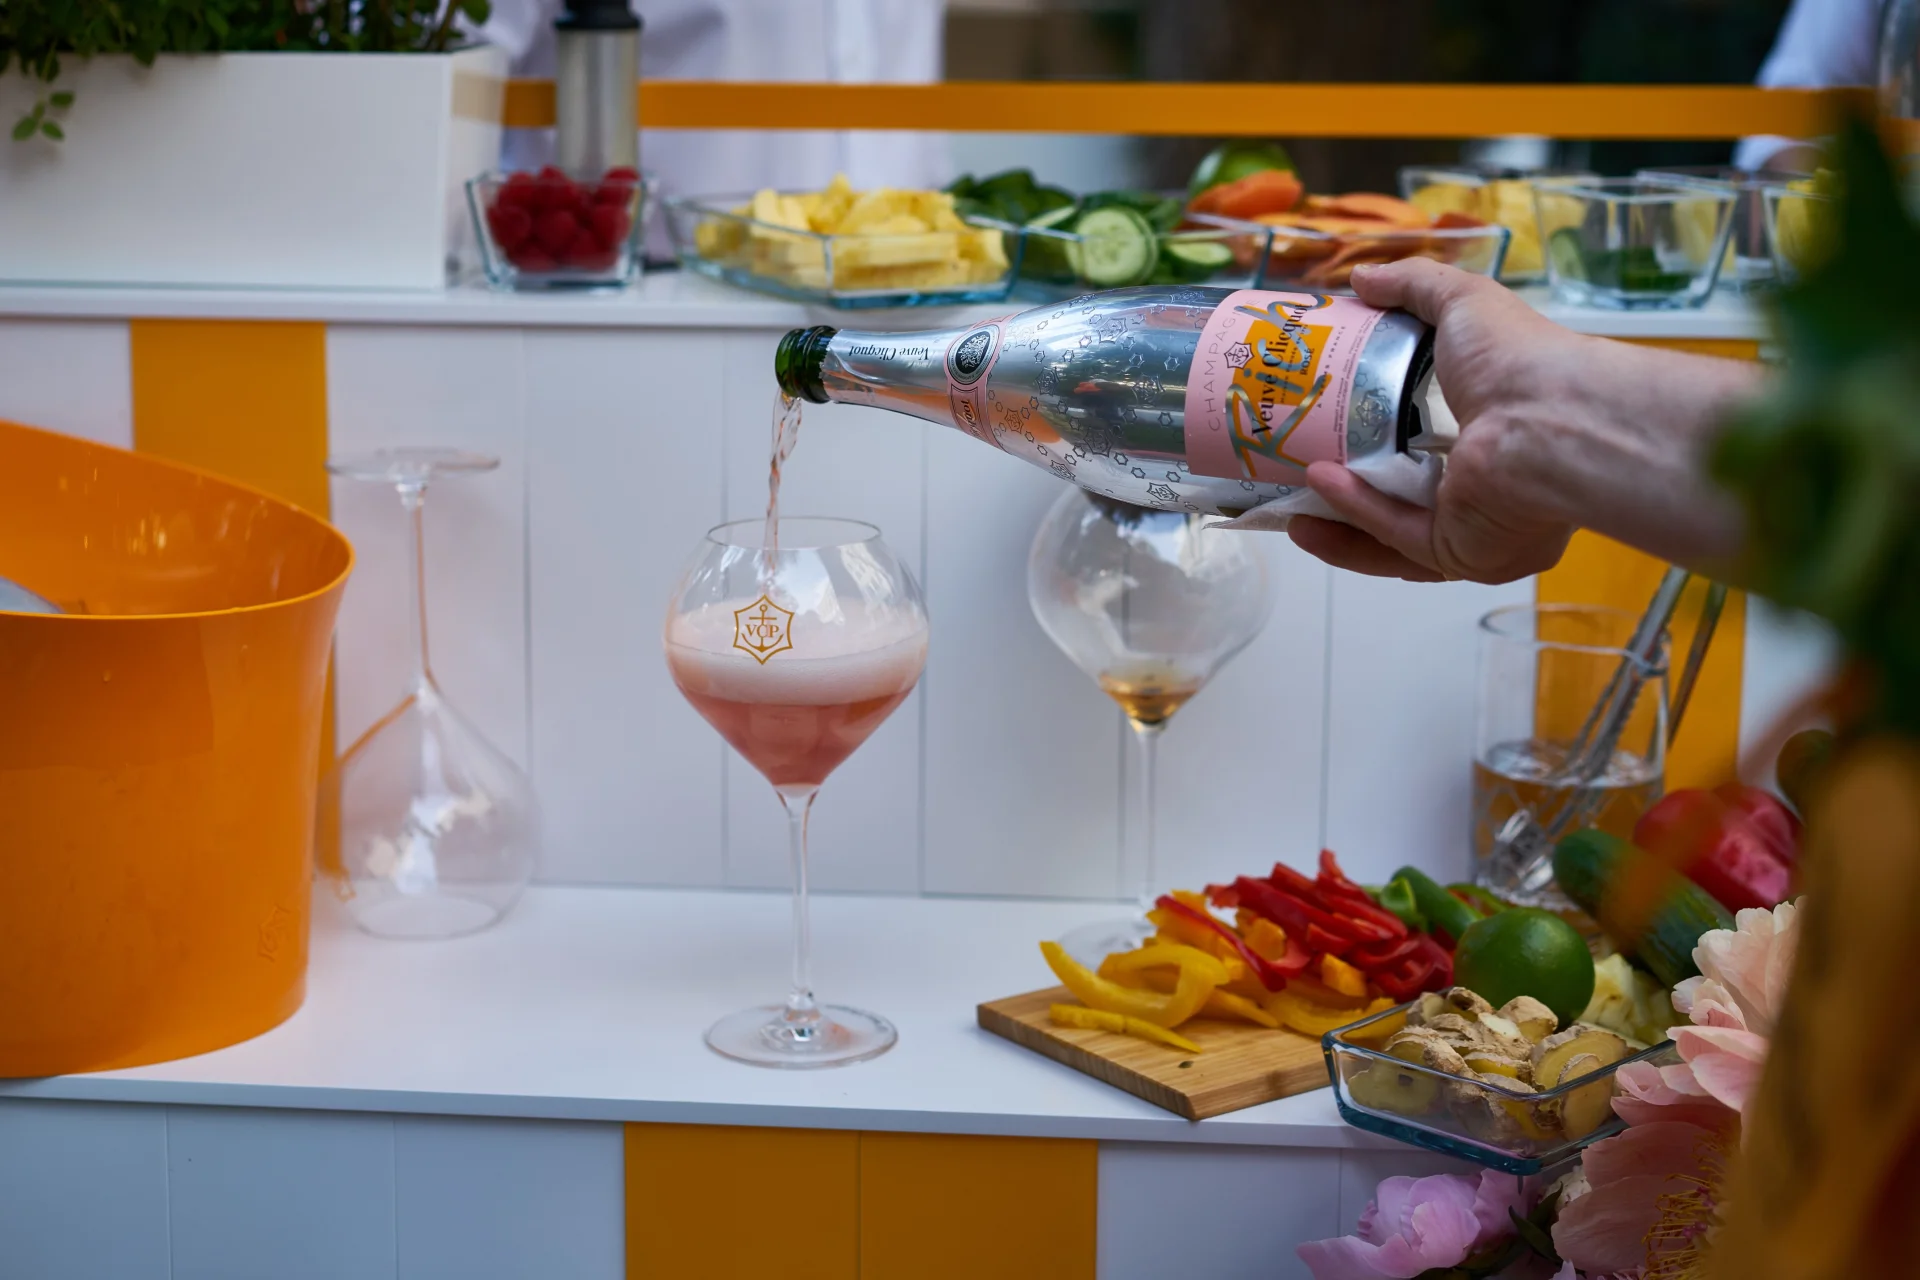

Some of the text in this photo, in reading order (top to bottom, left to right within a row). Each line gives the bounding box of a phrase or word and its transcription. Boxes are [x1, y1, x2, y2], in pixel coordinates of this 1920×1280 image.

[848, 345, 929, 360] Veuve Clicquot
[1327, 325, 1346, 358] FRANCE
[1204, 299, 1259, 432] CHAMPAGE
[1252, 304, 1313, 436] Veuve Clicquot
[1299, 346, 1315, 375] ROSÉ
[1225, 294, 1333, 478] Rich
[745, 624, 779, 638] VCP
